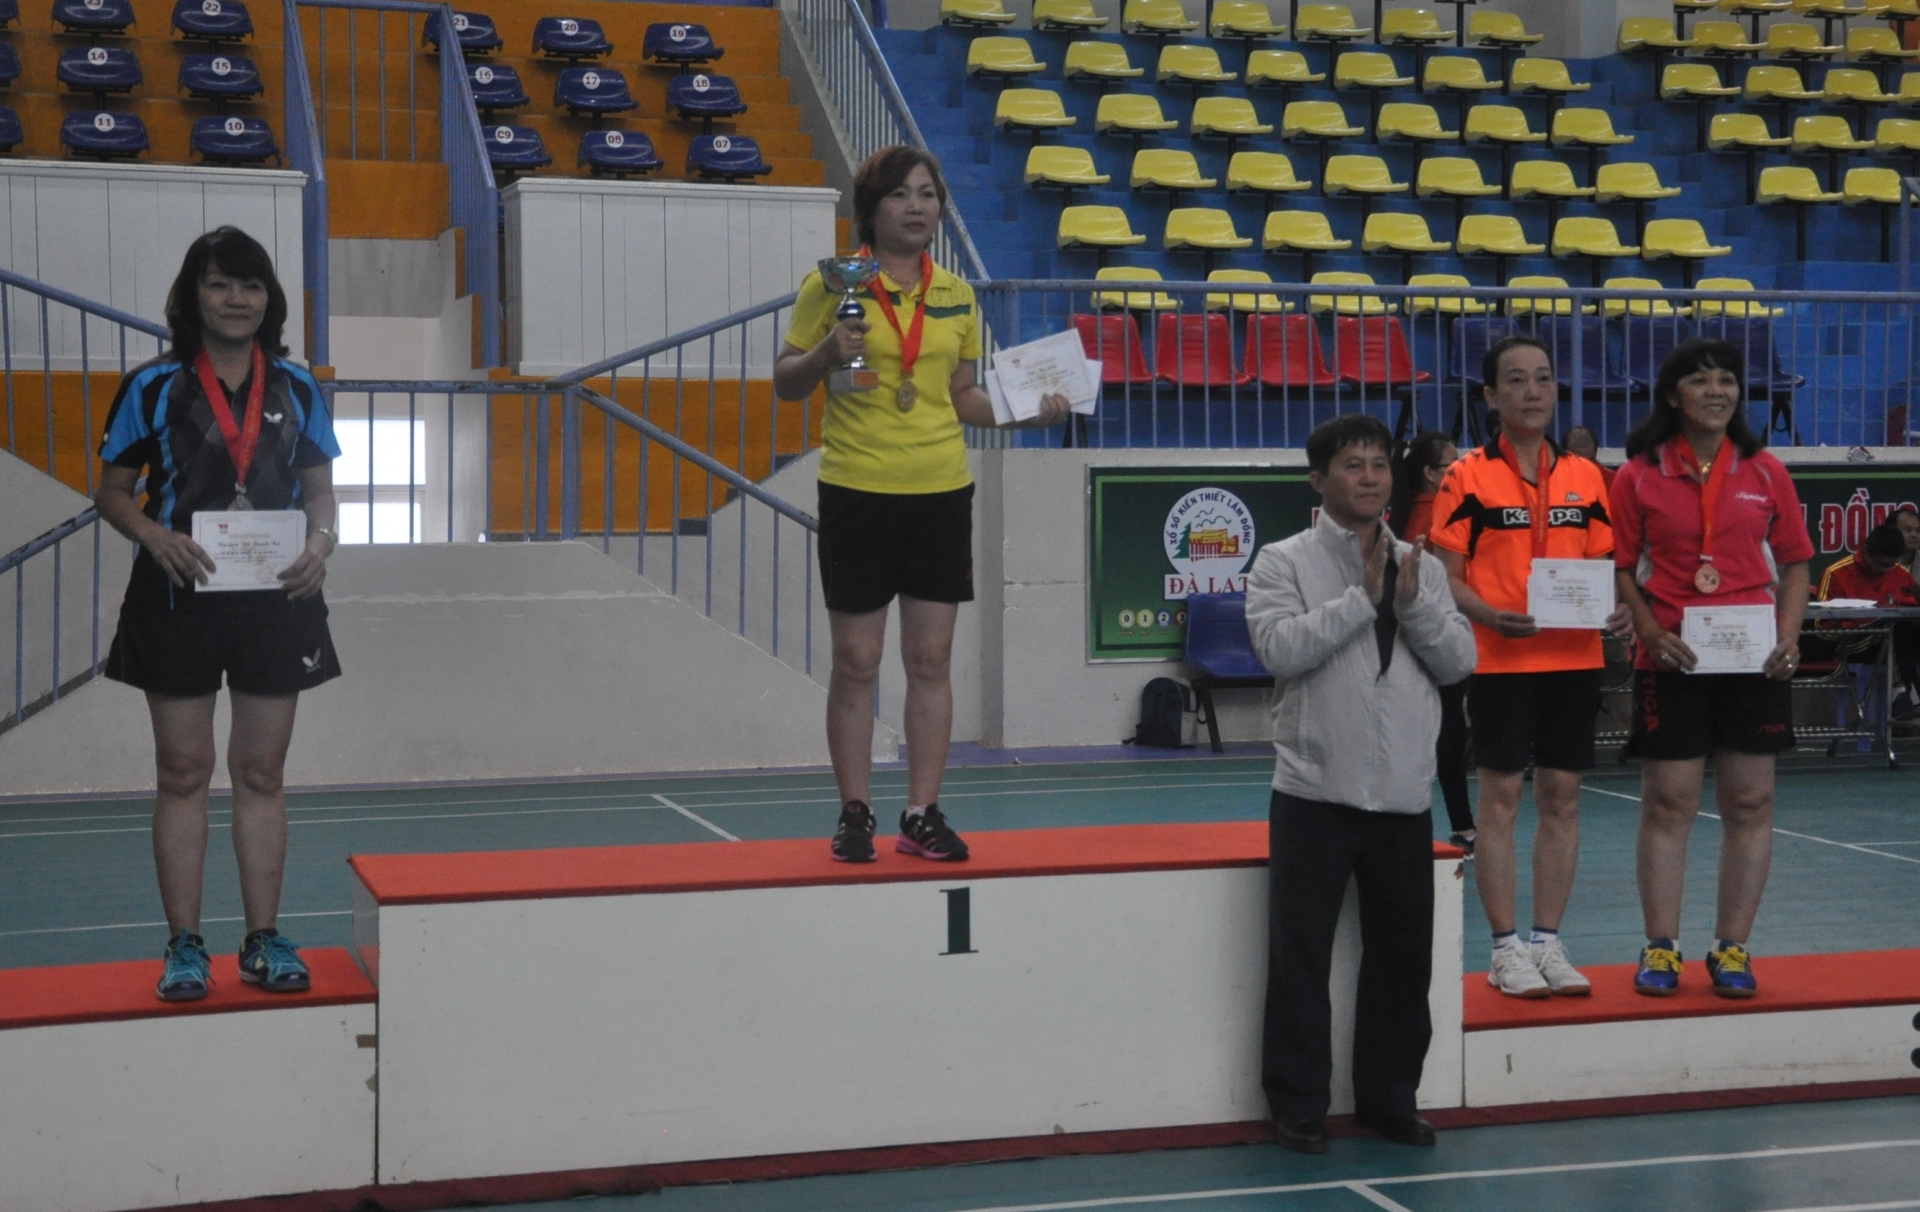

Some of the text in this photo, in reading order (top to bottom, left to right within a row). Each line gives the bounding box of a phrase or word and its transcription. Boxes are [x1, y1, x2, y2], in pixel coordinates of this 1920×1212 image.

[204, 2, 219, 12] 22
[454, 17, 465, 26] 21
[563, 22, 577, 32] 20
[671, 29, 684, 38] 19
[90, 52, 106, 61] 14
[214, 61, 229, 71] 15
[478, 70, 491, 80] 16
[584, 76, 598, 85] 17
[694, 79, 708, 88] 18
[97, 117, 112, 127] 11
[227, 122, 243, 132] 10
[607, 135, 622, 144] 08
[715, 139, 729, 148] 07
[1503, 508, 1582, 525] Kapa
[1819, 488, 1919, 553] ĐỒ
[1169, 572, 1200, 594] ĐÀ
[1124, 613, 1185, 622] 0 1 2 3
[939, 886, 979, 956] 1
